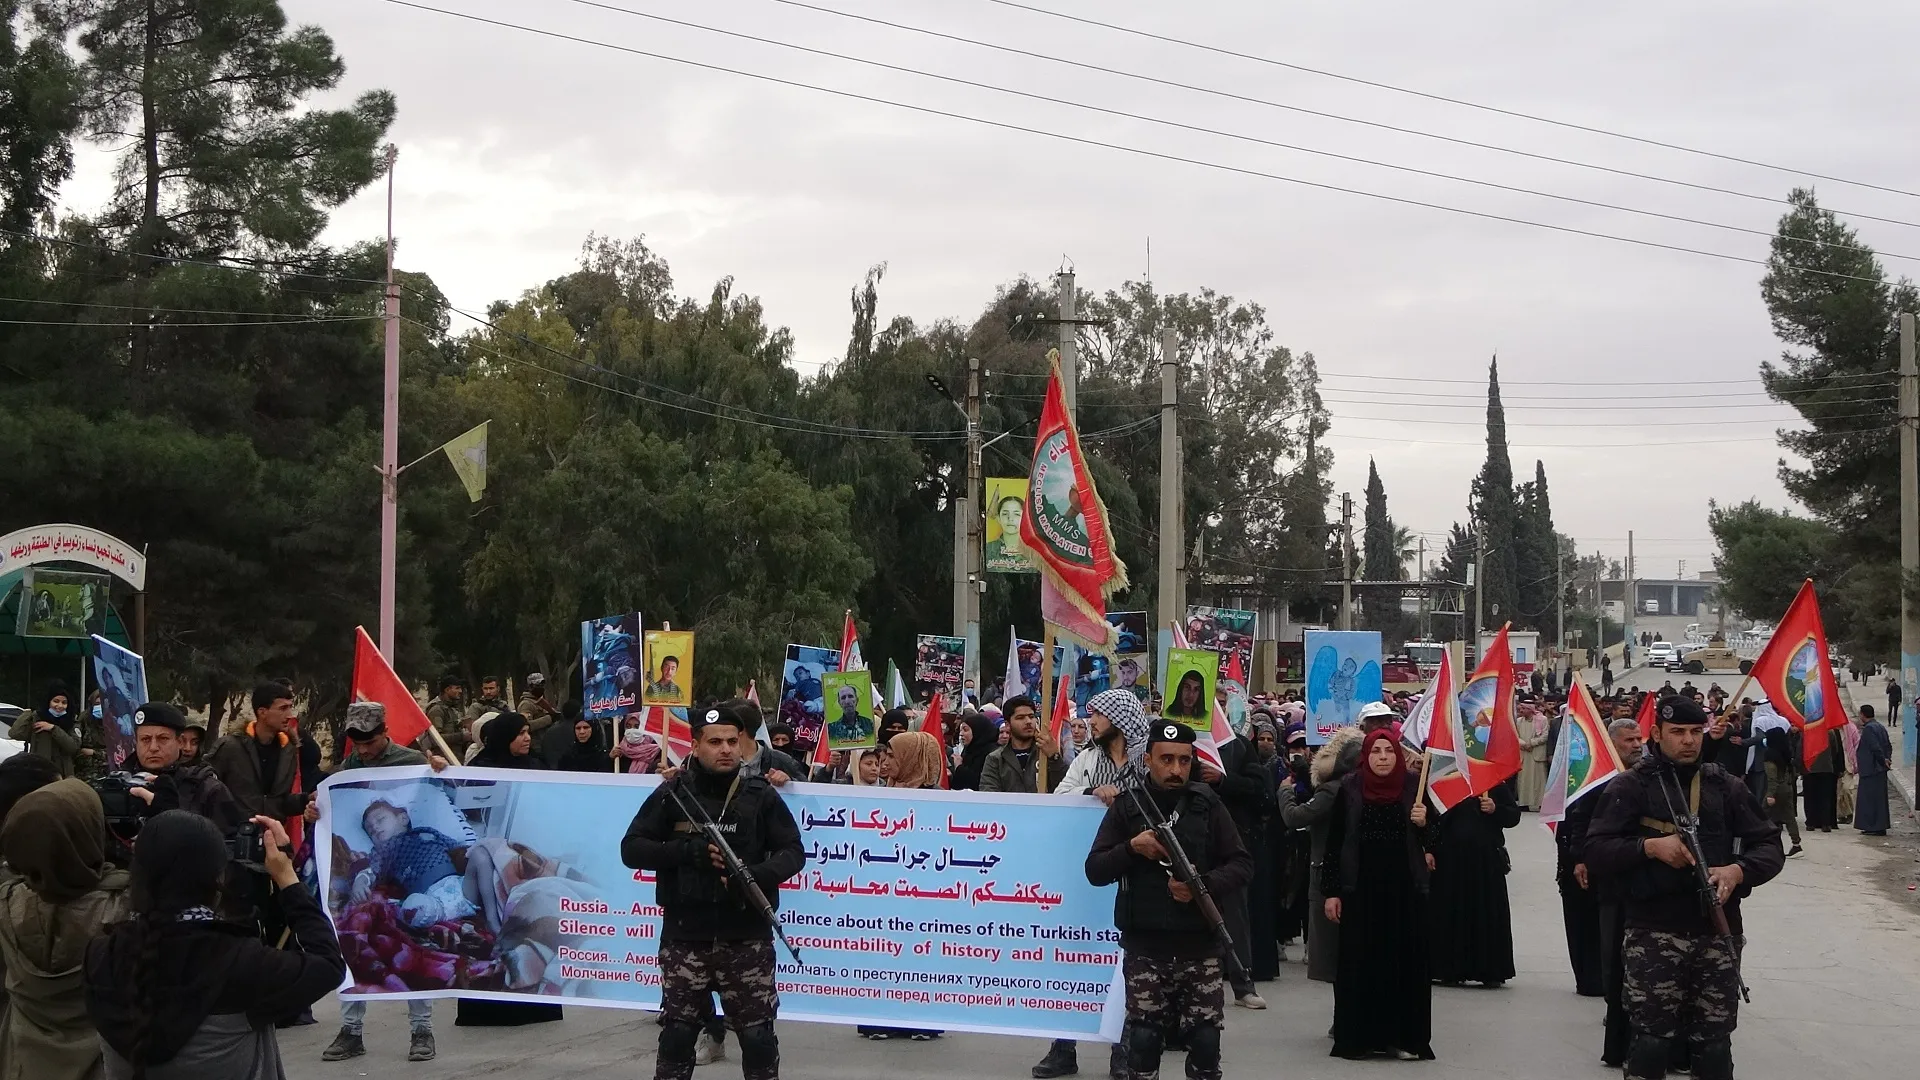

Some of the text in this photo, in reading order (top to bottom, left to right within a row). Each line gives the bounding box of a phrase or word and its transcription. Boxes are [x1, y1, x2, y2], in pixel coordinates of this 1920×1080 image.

[1035, 462, 1086, 557] MECLISA MALBATEN
[1051, 513, 1081, 540] MMS
[10, 542, 31, 559] وريفها
[31, 535, 54, 552] الطبقة
[53, 532, 62, 553] في
[62, 534, 82, 553] زنوبيا
[95, 544, 111, 561] تجمع
[110, 549, 125, 565] مكتب
[801, 807, 847, 832] كفوا
[850, 808, 915, 838] أمريكا
[947, 813, 1007, 842] روسيا
[804, 840, 1002, 875] حيال جرائم الدول
[812, 869, 890, 899] محاسبة
[893, 878, 968, 900] الصمت
[971, 880, 1063, 911] سيكلفكم
[560, 898, 609, 914] Russia
[630, 902, 665, 917] Ame
[779, 910, 832, 927] silence
[836, 914, 884, 930] about
[888, 917, 914, 932] the
[919, 919, 971, 935] crimes
[976, 922, 994, 936] of
[999, 923, 1026, 938] the
[1030, 925, 1091, 942] Turkish
[1096, 930, 1121, 942] sta
[559, 920, 1119, 965] Silence will accountability of history and humani
[559, 947, 1111, 996] Россия... Амер молчать о преступлениях турецкого государс
[561, 965, 631, 982] Молчание
[776, 981, 881, 998] ветственности
[886, 988, 930, 1003] перед
[934, 992, 1001, 1007] историей
[1006, 996, 1015, 1007] и
[1020, 996, 1105, 1013] человечест
